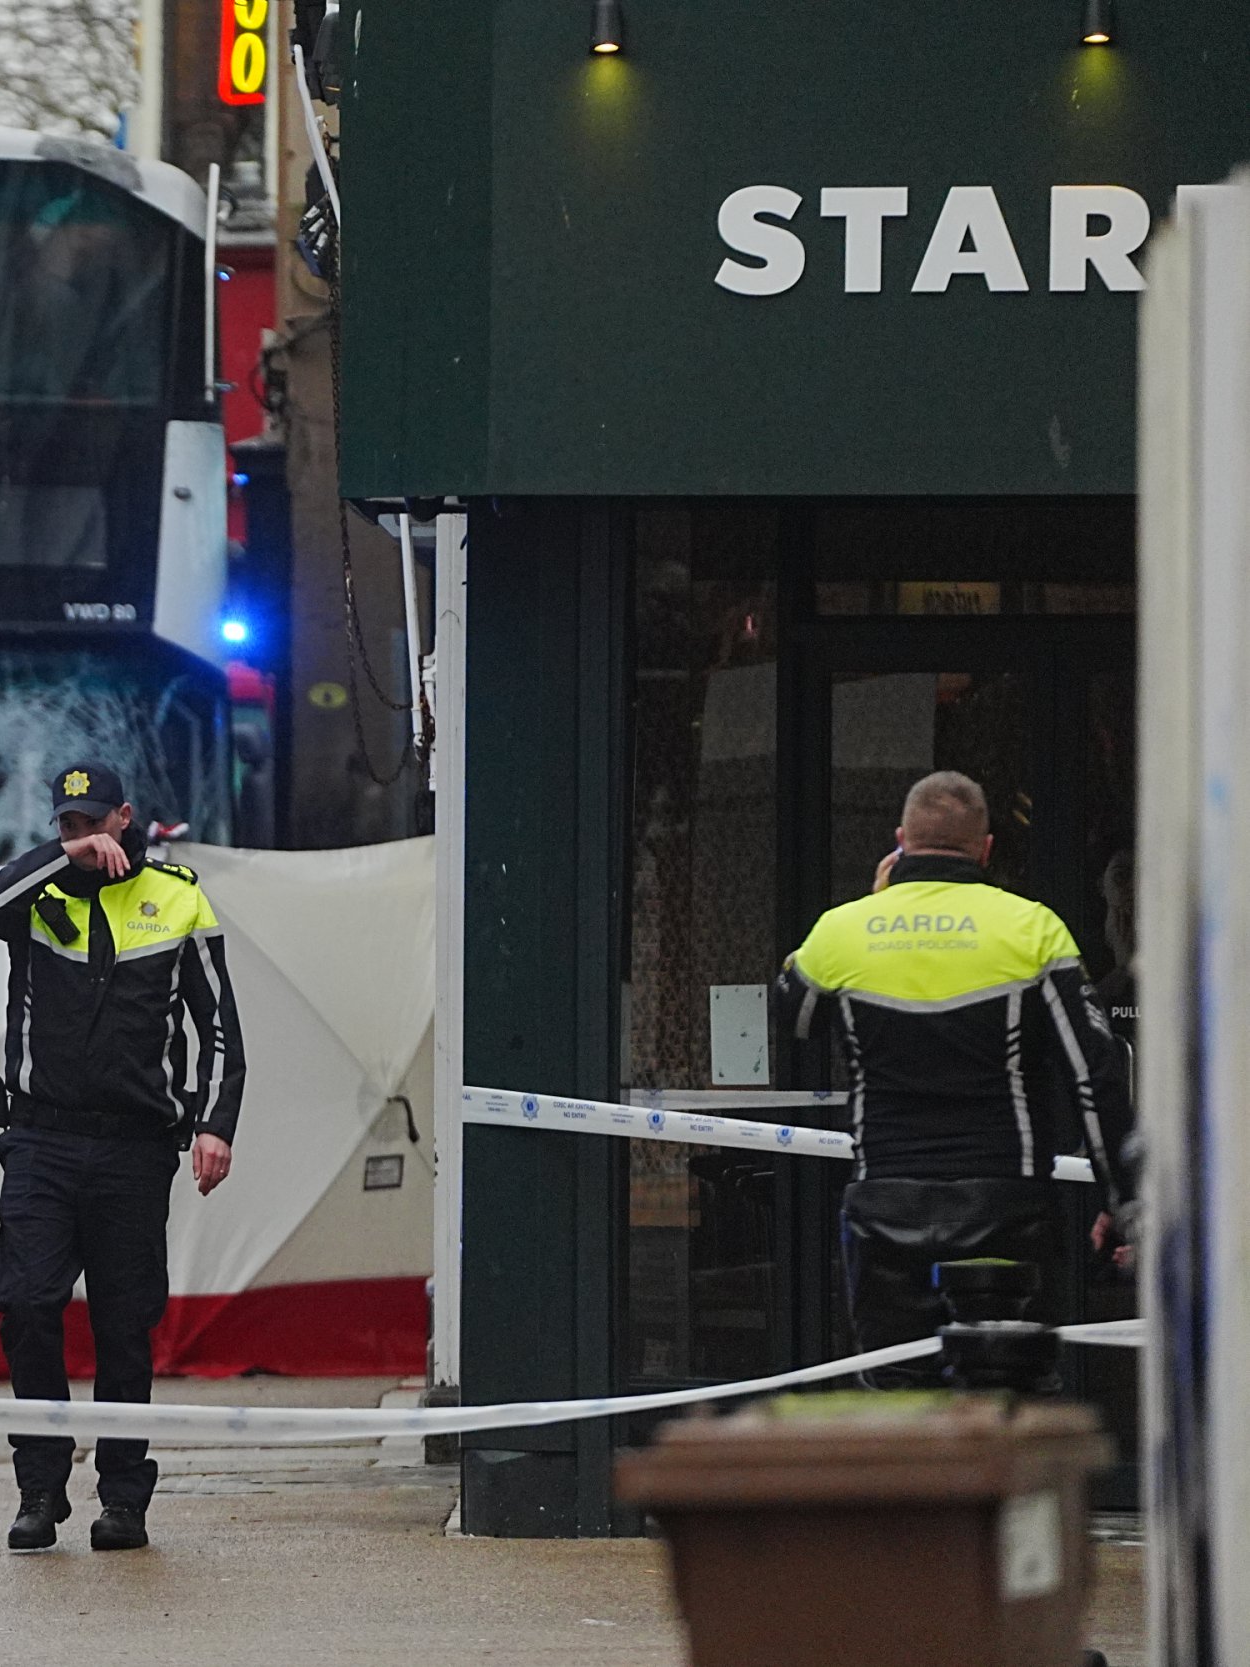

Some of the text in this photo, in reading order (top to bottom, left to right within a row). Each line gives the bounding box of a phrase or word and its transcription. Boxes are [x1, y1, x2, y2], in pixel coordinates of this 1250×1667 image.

[714, 184, 1245, 296] STAR
[126, 921, 171, 933] GARDA
[866, 913, 978, 934] GARDA
[867, 939, 979, 953] ROADS POLICING
[1111, 1006, 1141, 1018] PULL
